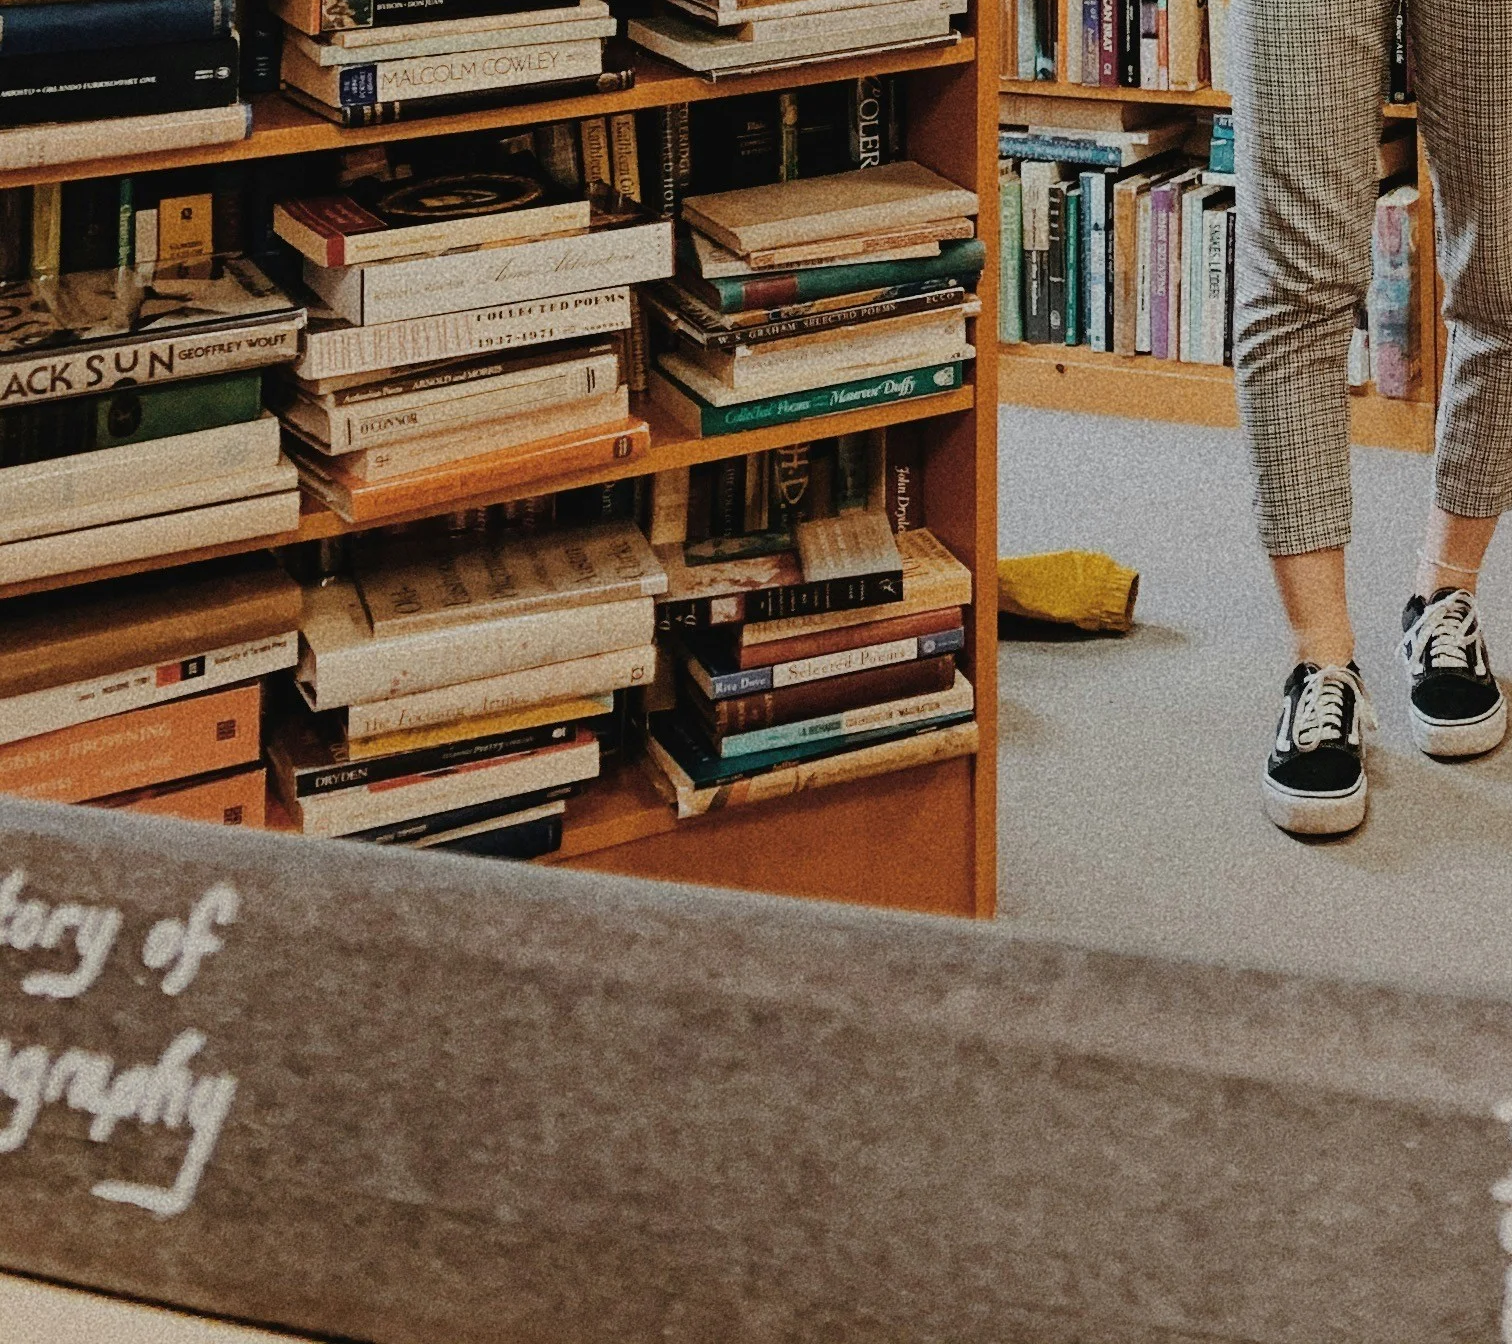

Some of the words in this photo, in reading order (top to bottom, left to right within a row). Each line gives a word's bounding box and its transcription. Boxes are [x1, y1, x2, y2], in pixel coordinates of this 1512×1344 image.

[1103, 23, 1113, 52] BRAT
[382, 64, 476, 88] MALCOLM
[482, 52, 559, 78] COWLEY
[574, 292, 625, 309] POEMS
[926, 293, 955, 304] ECCO
[86, 344, 175, 388] SUN
[178, 338, 242, 361] GEOFFREY
[246, 333, 287, 347] WOLFF
[788, 658, 852, 680] Selected
[860, 649, 905, 666] Poems
[714, 682, 738, 694] Rita
[740, 676, 767, 688] Dove
[315, 767, 368, 789] DRYDEN
[142, 881, 240, 996] of
[0, 1026, 239, 1217] graphy
